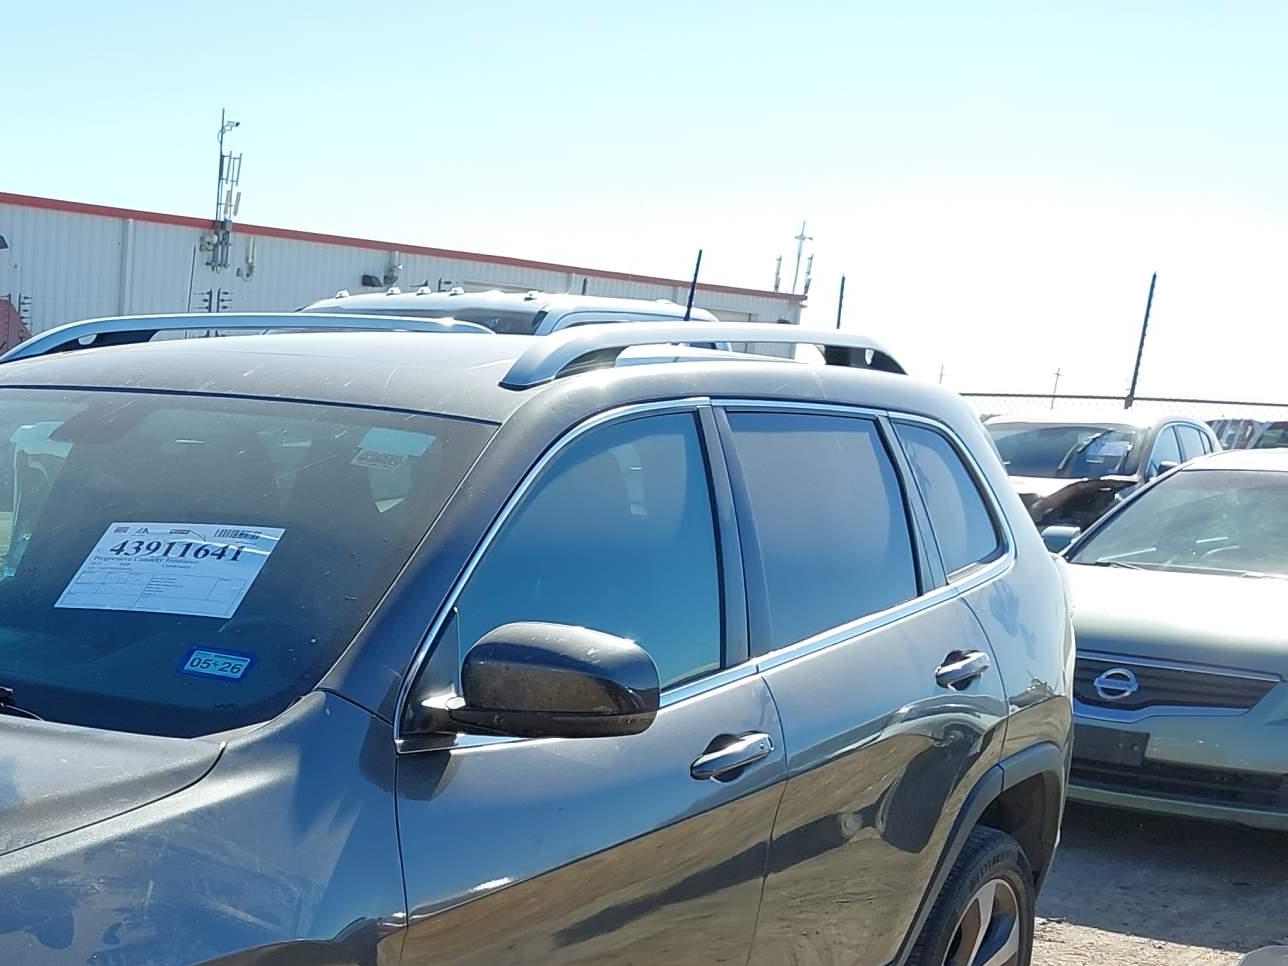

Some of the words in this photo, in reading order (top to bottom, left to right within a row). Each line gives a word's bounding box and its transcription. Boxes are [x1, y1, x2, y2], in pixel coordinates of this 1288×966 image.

[110, 539, 247, 562] 43911641
[190, 657, 213, 669] 05
[218, 661, 244, 675] 26
